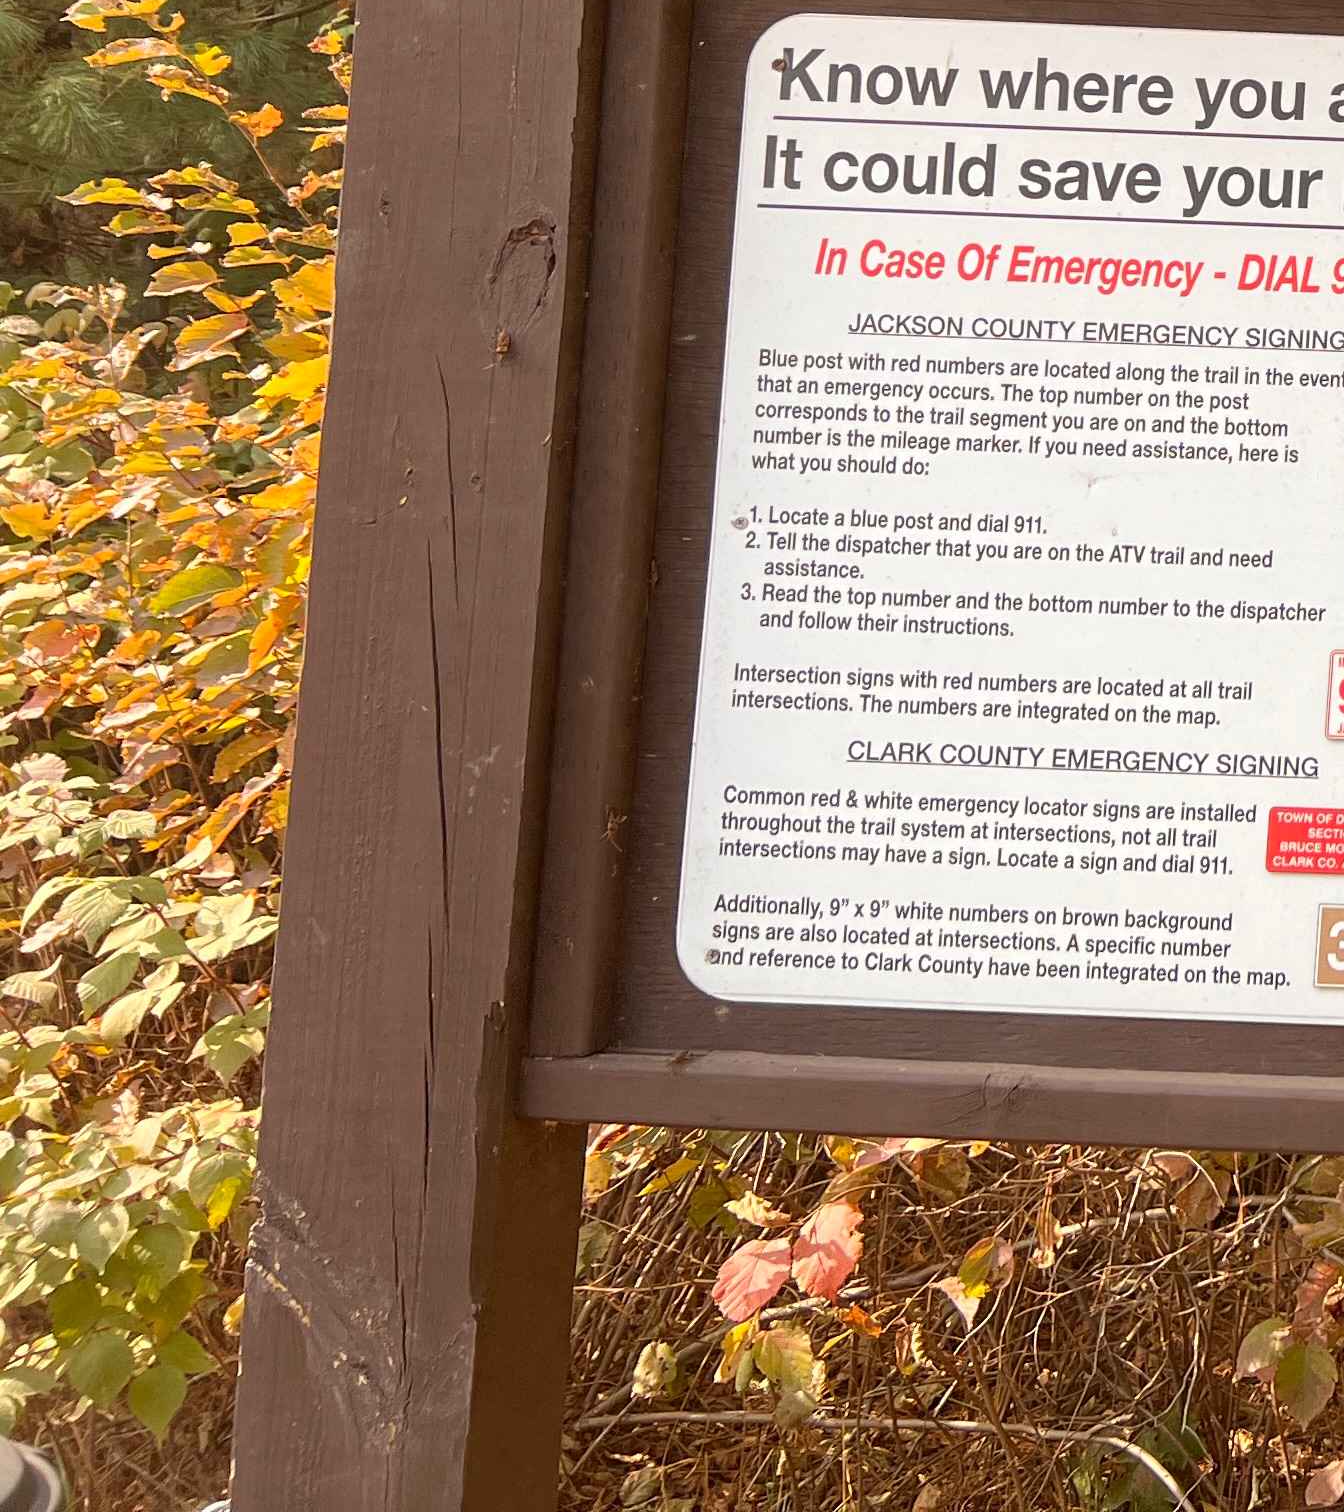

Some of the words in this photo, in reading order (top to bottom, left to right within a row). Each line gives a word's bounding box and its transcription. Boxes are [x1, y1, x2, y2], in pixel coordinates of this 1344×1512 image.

[779, 47, 959, 107] Know
[978, 57, 1173, 116] where
[1194, 77, 1306, 129] you
[763, 134, 803, 190] It
[823, 141, 997, 197] could
[1018, 158, 1161, 204] save
[1182, 165, 1324, 217] your
[815, 237, 848, 275] In
[859, 238, 945, 280] Case
[956, 242, 1002, 281] Of
[1006, 244, 1204, 296] Emergency
[1214, 271, 1226, 280] -
[1237, 253, 1320, 294] DIAL
[848, 313, 963, 335] JACKSON
[971, 317, 1076, 340] COUNTY
[1082, 322, 1238, 346] EMERGENCY
[758, 348, 798, 367] Blue
[803, 352, 843, 372] post
[848, 352, 885, 371] with
[891, 354, 920, 372] red
[926, 356, 1004, 376] numbers
[1009, 362, 1039, 377] are
[1044, 359, 1111, 379] located
[1115, 362, 1165, 386] along
[1170, 364, 1199, 382] the
[1204, 365, 1239, 384] trail
[1244, 366, 1259, 385] in
[1265, 367, 1294, 386] the
[757, 374, 792, 393] that
[796, 380, 818, 394] an
[824, 381, 923, 402] emergency
[928, 385, 994, 401] occurs.
[1000, 383, 1034, 402] The
[1038, 385, 1068, 407] top
[1073, 387, 1143, 406] number
[1147, 393, 1169, 407] on
[1175, 390, 1204, 408] the
[1209, 392, 1249, 413] post
[755, 403, 867, 423] corresponds
[873, 405, 890, 422] to
[895, 405, 924, 424] the
[929, 407, 964, 425] trail
[969, 411, 1047, 431] segment
[1051, 415, 1084, 433] you
[1089, 416, 1118, 431] are
[1124, 418, 1146, 432] on
[1151, 415, 1185, 433] and
[1189, 415, 1219, 435] the
[1224, 416, 1288, 437] bottom
[753, 426, 822, 445] number
[826, 427, 841, 446] is
[846, 429, 875, 448] the
[880, 430, 951, 454] mileage
[956, 434, 1022, 453] marker.
[1028, 435, 1041, 454] If
[1044, 440, 1077, 458] you
[1082, 439, 1127, 457] need
[1132, 441, 1232, 464] assistance,
[1238, 443, 1278, 462] here
[1284, 449, 1299, 463] is
[751, 451, 795, 470] what
[799, 456, 831, 474] you
[837, 454, 896, 474] should
[902, 456, 930, 475] do:
[749, 505, 762, 523] 1.
[768, 505, 829, 526] Locate
[834, 512, 845, 526] a
[850, 508, 888, 528] blue
[893, 512, 933, 533] post
[938, 513, 972, 531] and
[977, 513, 1009, 532] dial
[1014, 515, 1047, 534] 911.
[848, 741, 933, 763] CLARK
[940, 744, 1046, 767] COUNTY
[1051, 749, 1210, 774] EMERGENCY
[1215, 756, 1320, 778] SIGNING
[1277, 811, 1313, 823] TOWN
[1315, 813, 1333, 824] OF
[1272, 855, 1314, 867] CLARK
[1317, 858, 1340, 869] CO.
[1279, 841, 1321, 853] BRUCE
